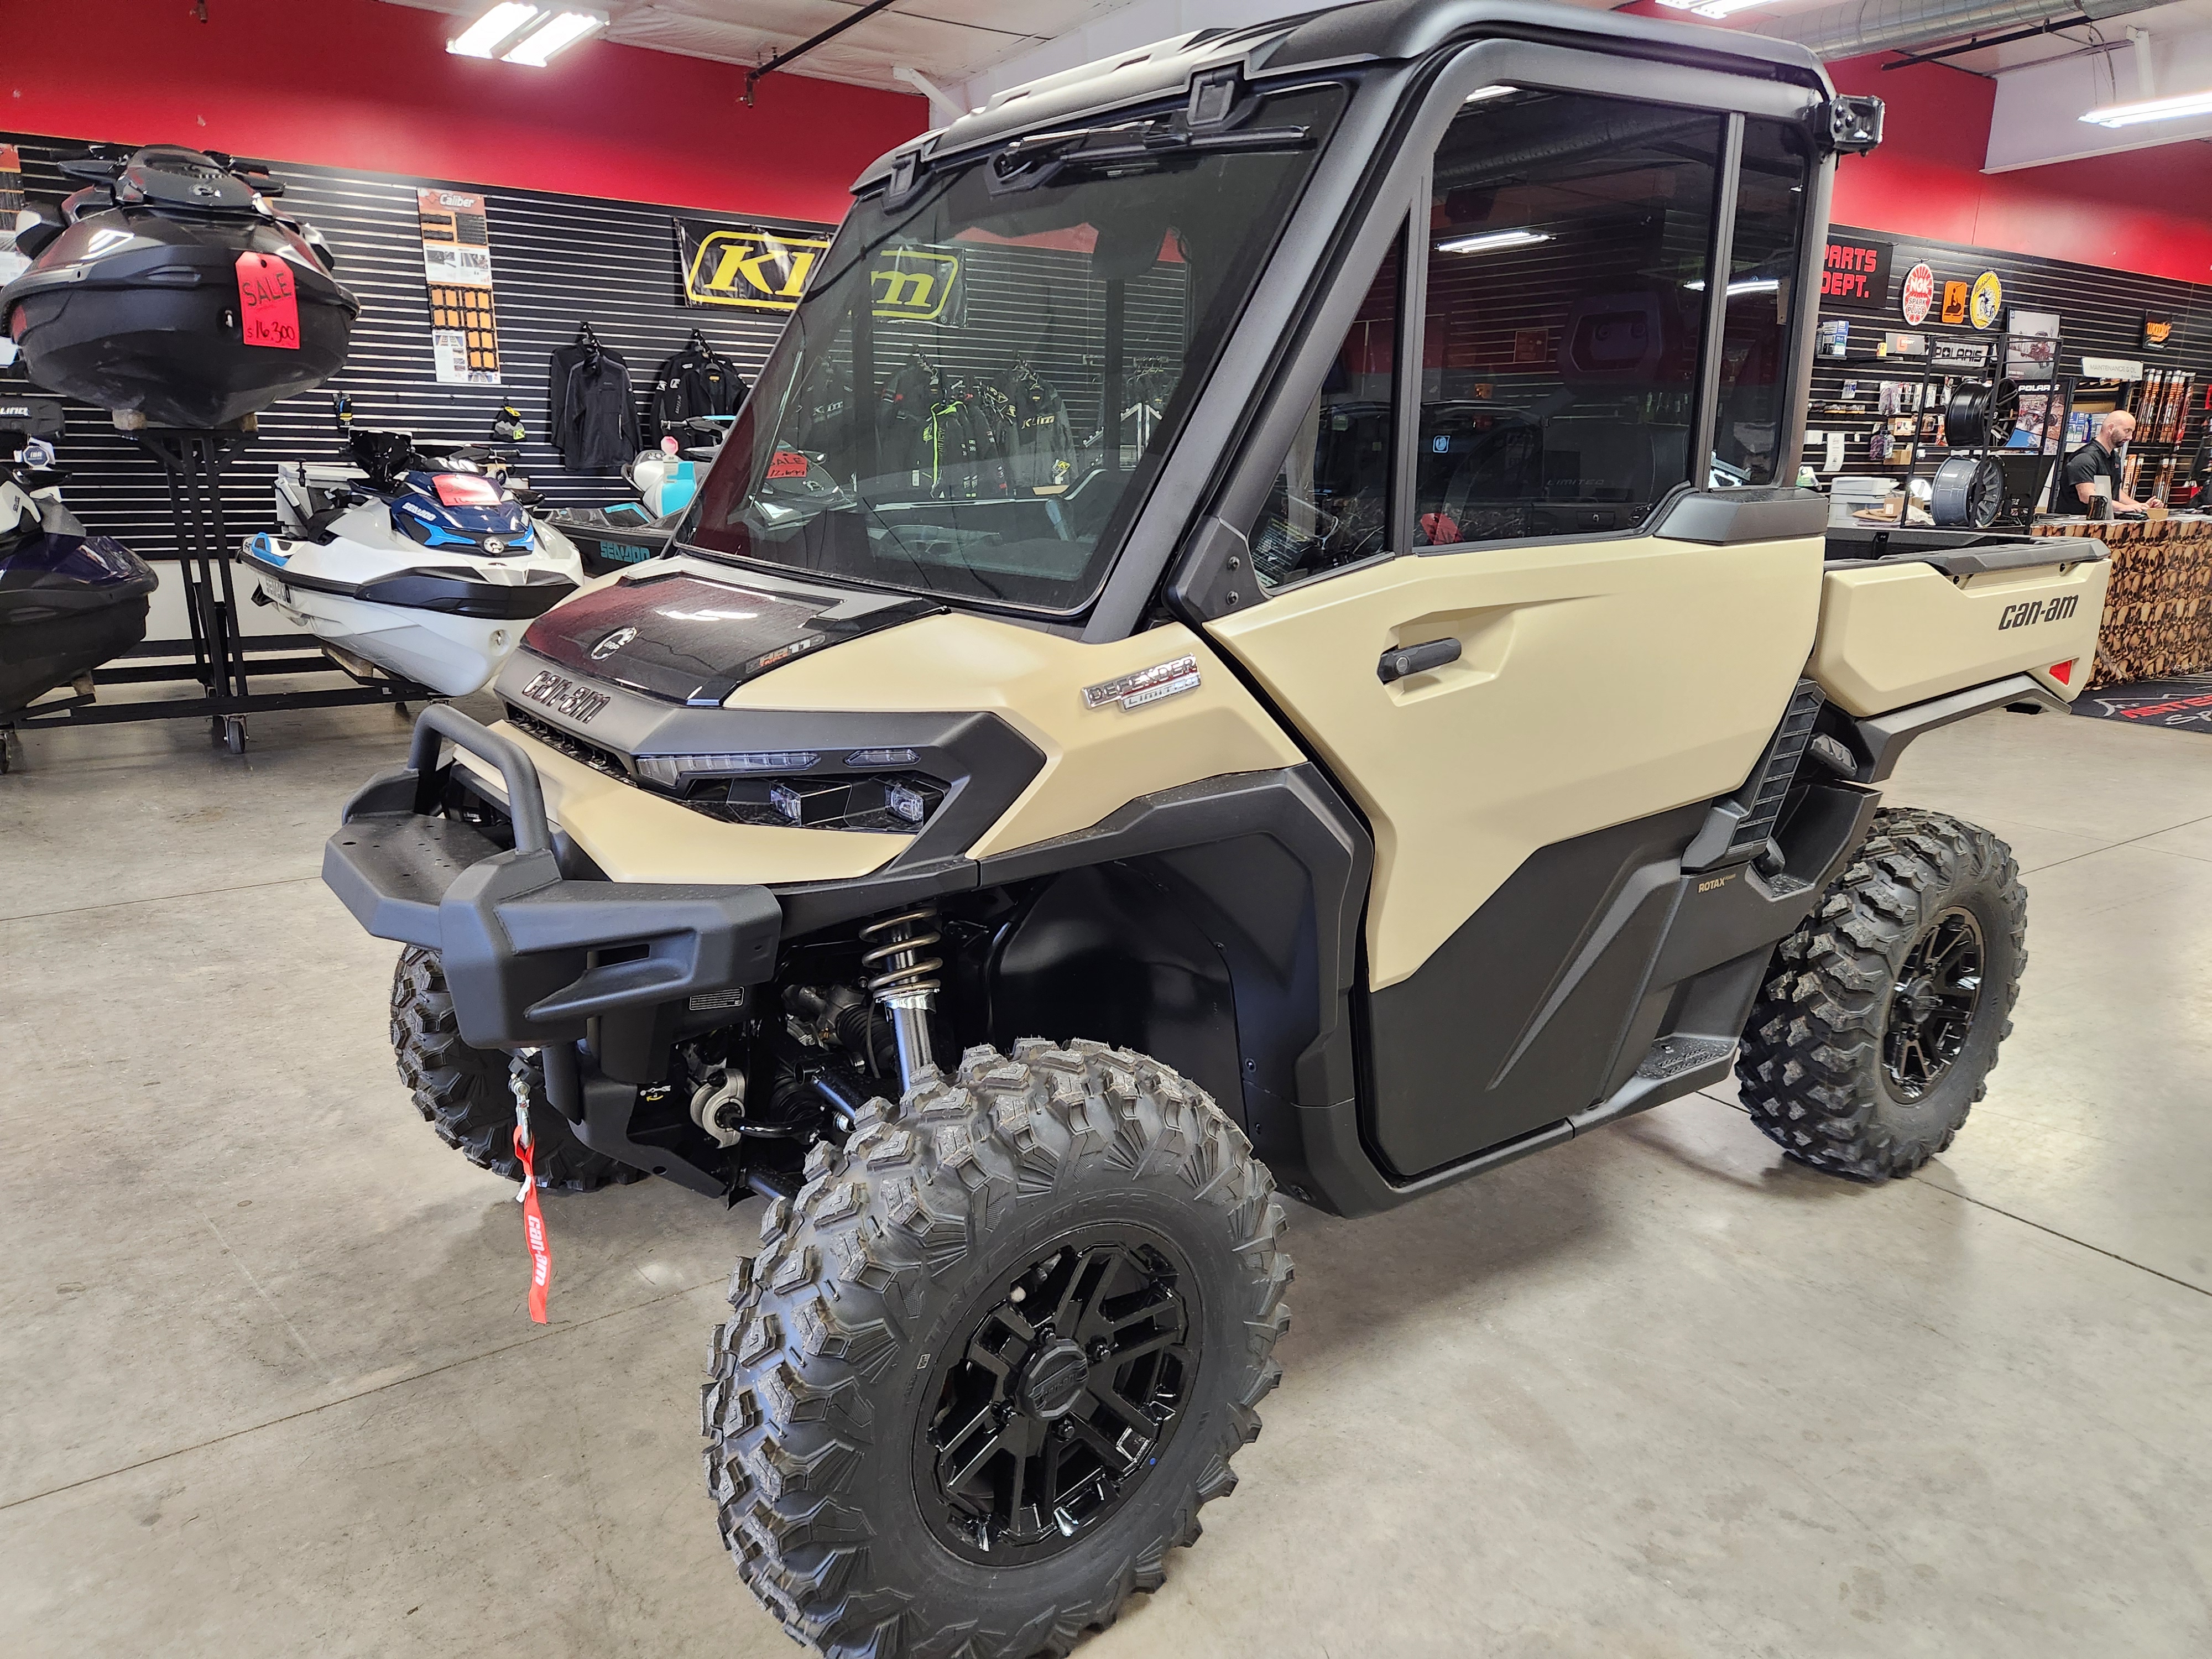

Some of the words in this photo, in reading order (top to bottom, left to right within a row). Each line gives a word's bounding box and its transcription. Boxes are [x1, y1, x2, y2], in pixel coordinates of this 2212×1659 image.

[440, 194, 475, 208] Caliber
[242, 273, 291, 306] SALE
[1820, 271, 1869, 298] DEPT.
[1910, 277, 1929, 294] NGK
[1909, 298, 1926, 306] SPARK
[1907, 306, 1926, 315] PLUGS
[1936, 346, 1984, 362] POLARIS
[2090, 364, 2127, 373] MAINTENANCE
[1998, 594, 2079, 630] can-am
[604, 640, 620, 650] BRP
[1088, 656, 1197, 701] DEFENDER
[523, 670, 611, 724] can-am
[1698, 877, 1725, 893] ROTAX
[528, 1214, 547, 1287] can-am
